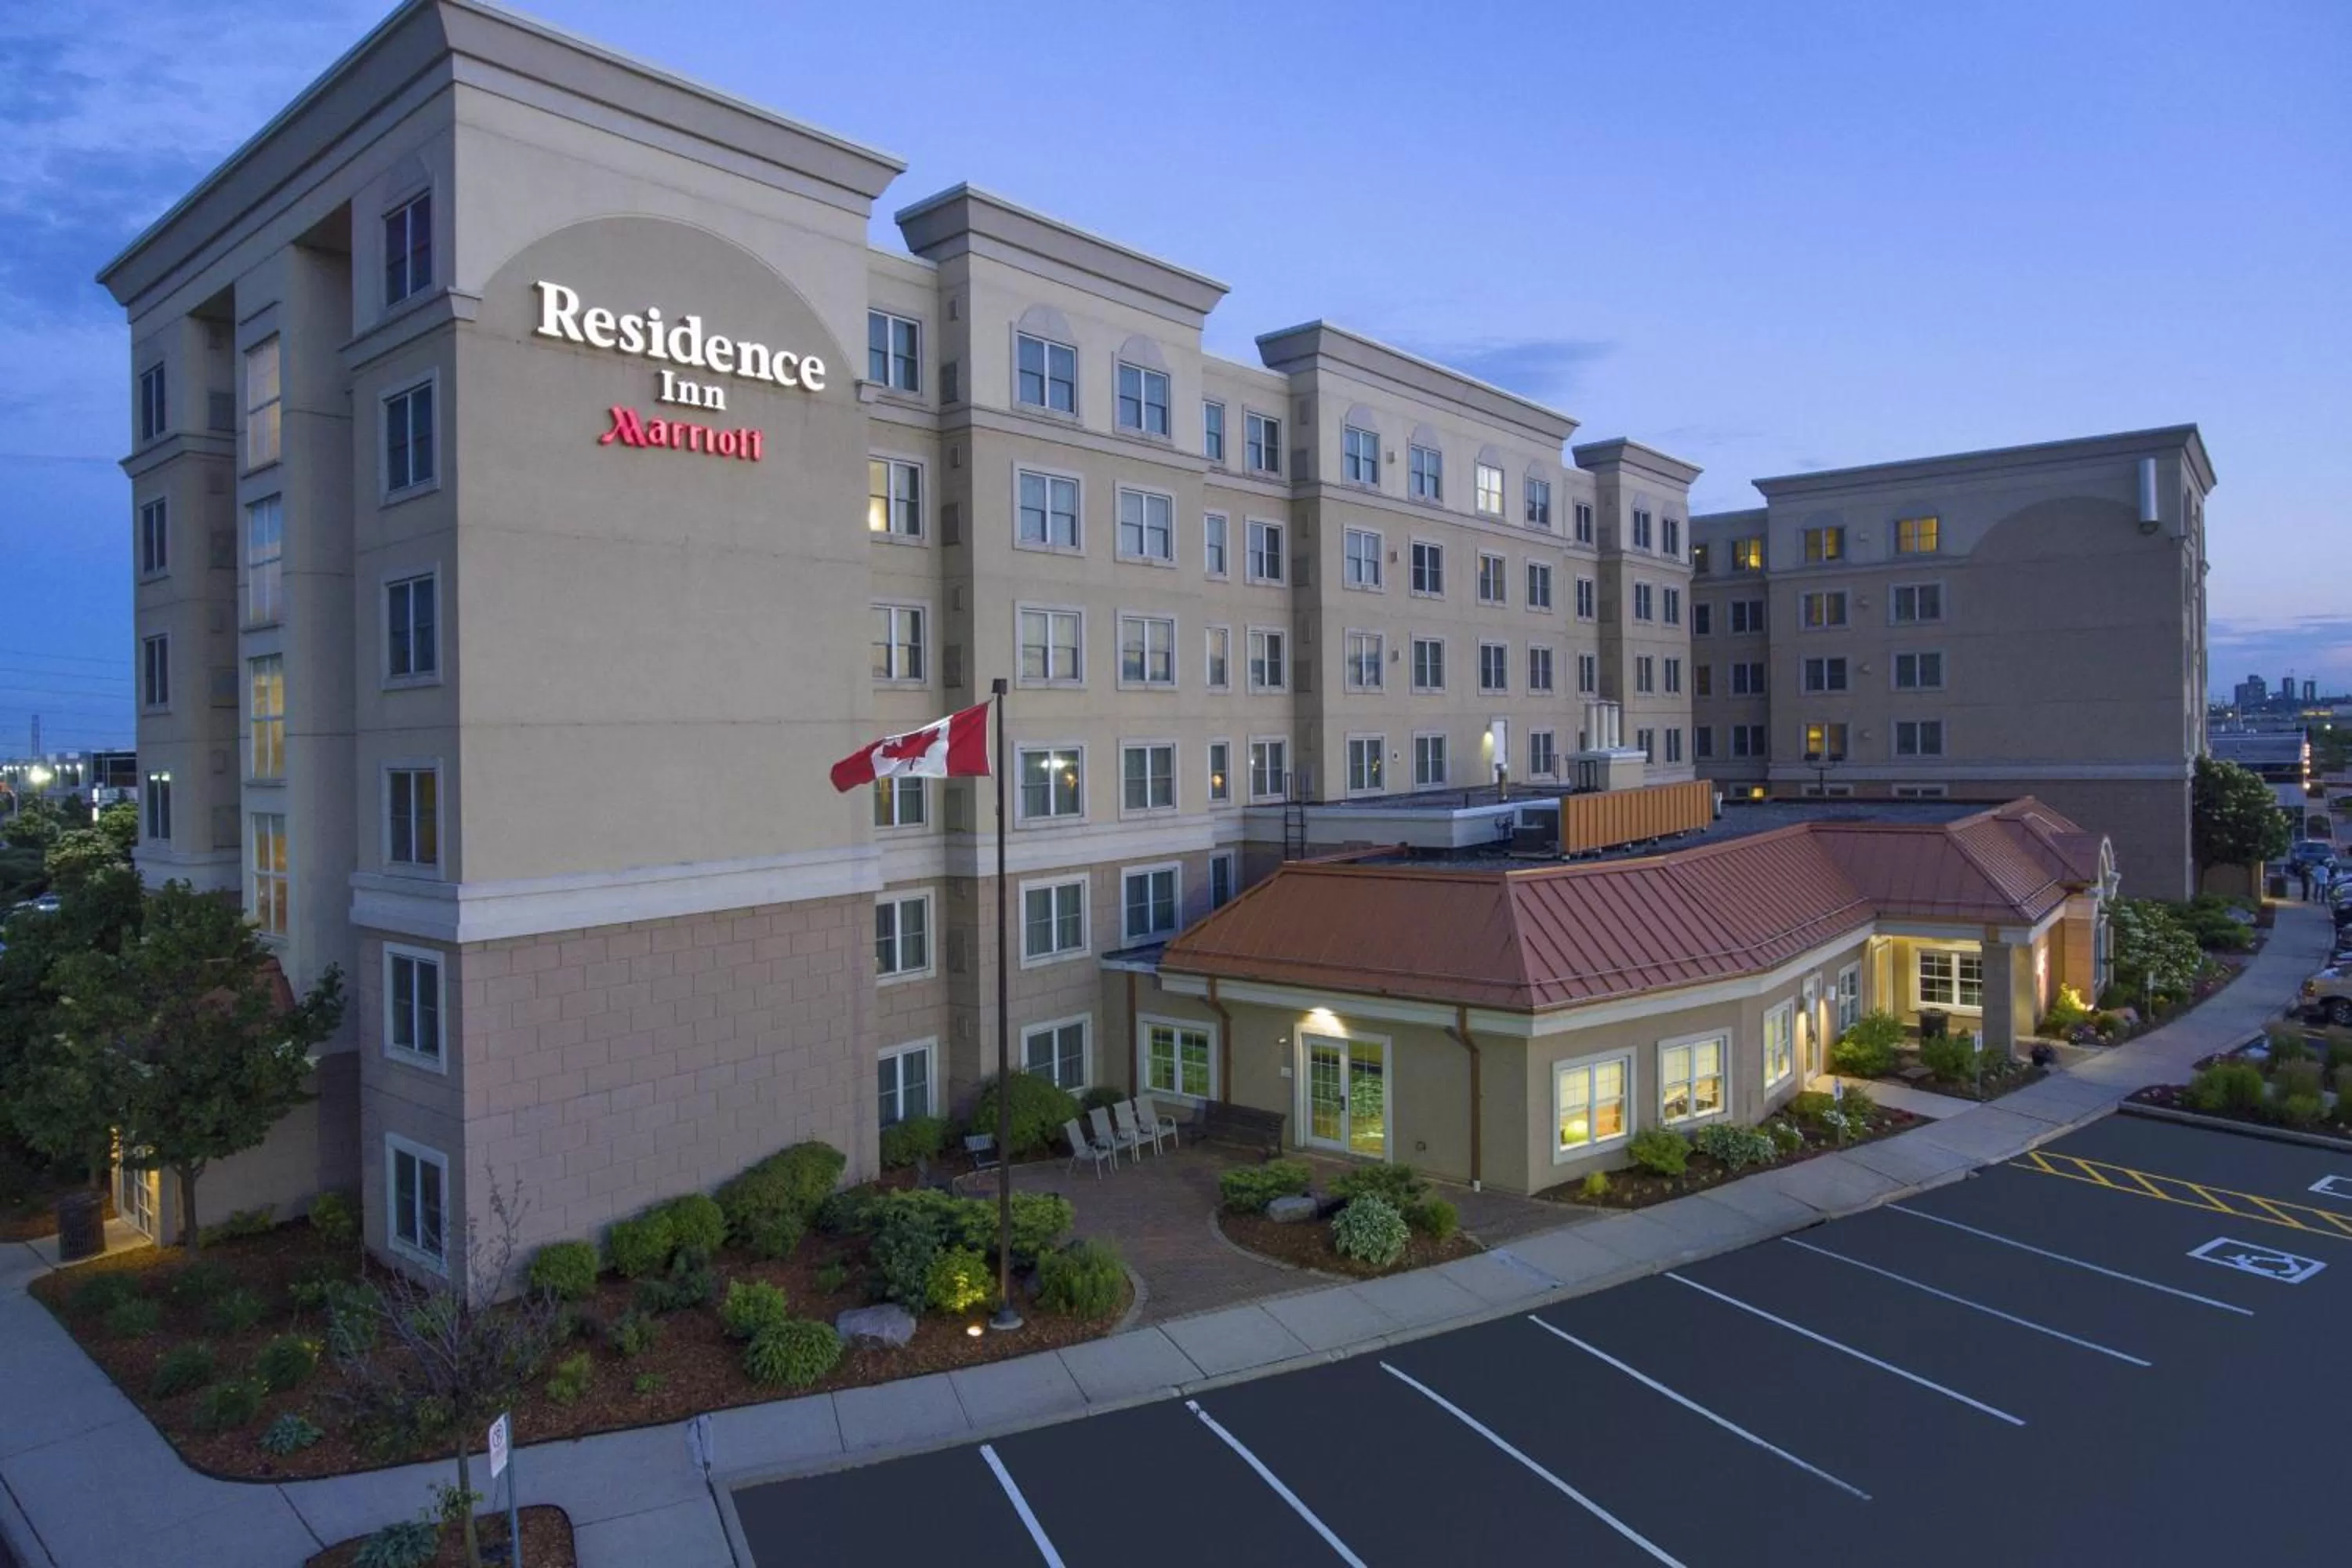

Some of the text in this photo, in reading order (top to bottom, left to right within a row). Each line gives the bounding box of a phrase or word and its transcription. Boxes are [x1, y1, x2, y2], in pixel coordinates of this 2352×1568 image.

[536, 280, 826, 391] Residence
[659, 369, 726, 410] Inn
[599, 406, 763, 461] Marriott
